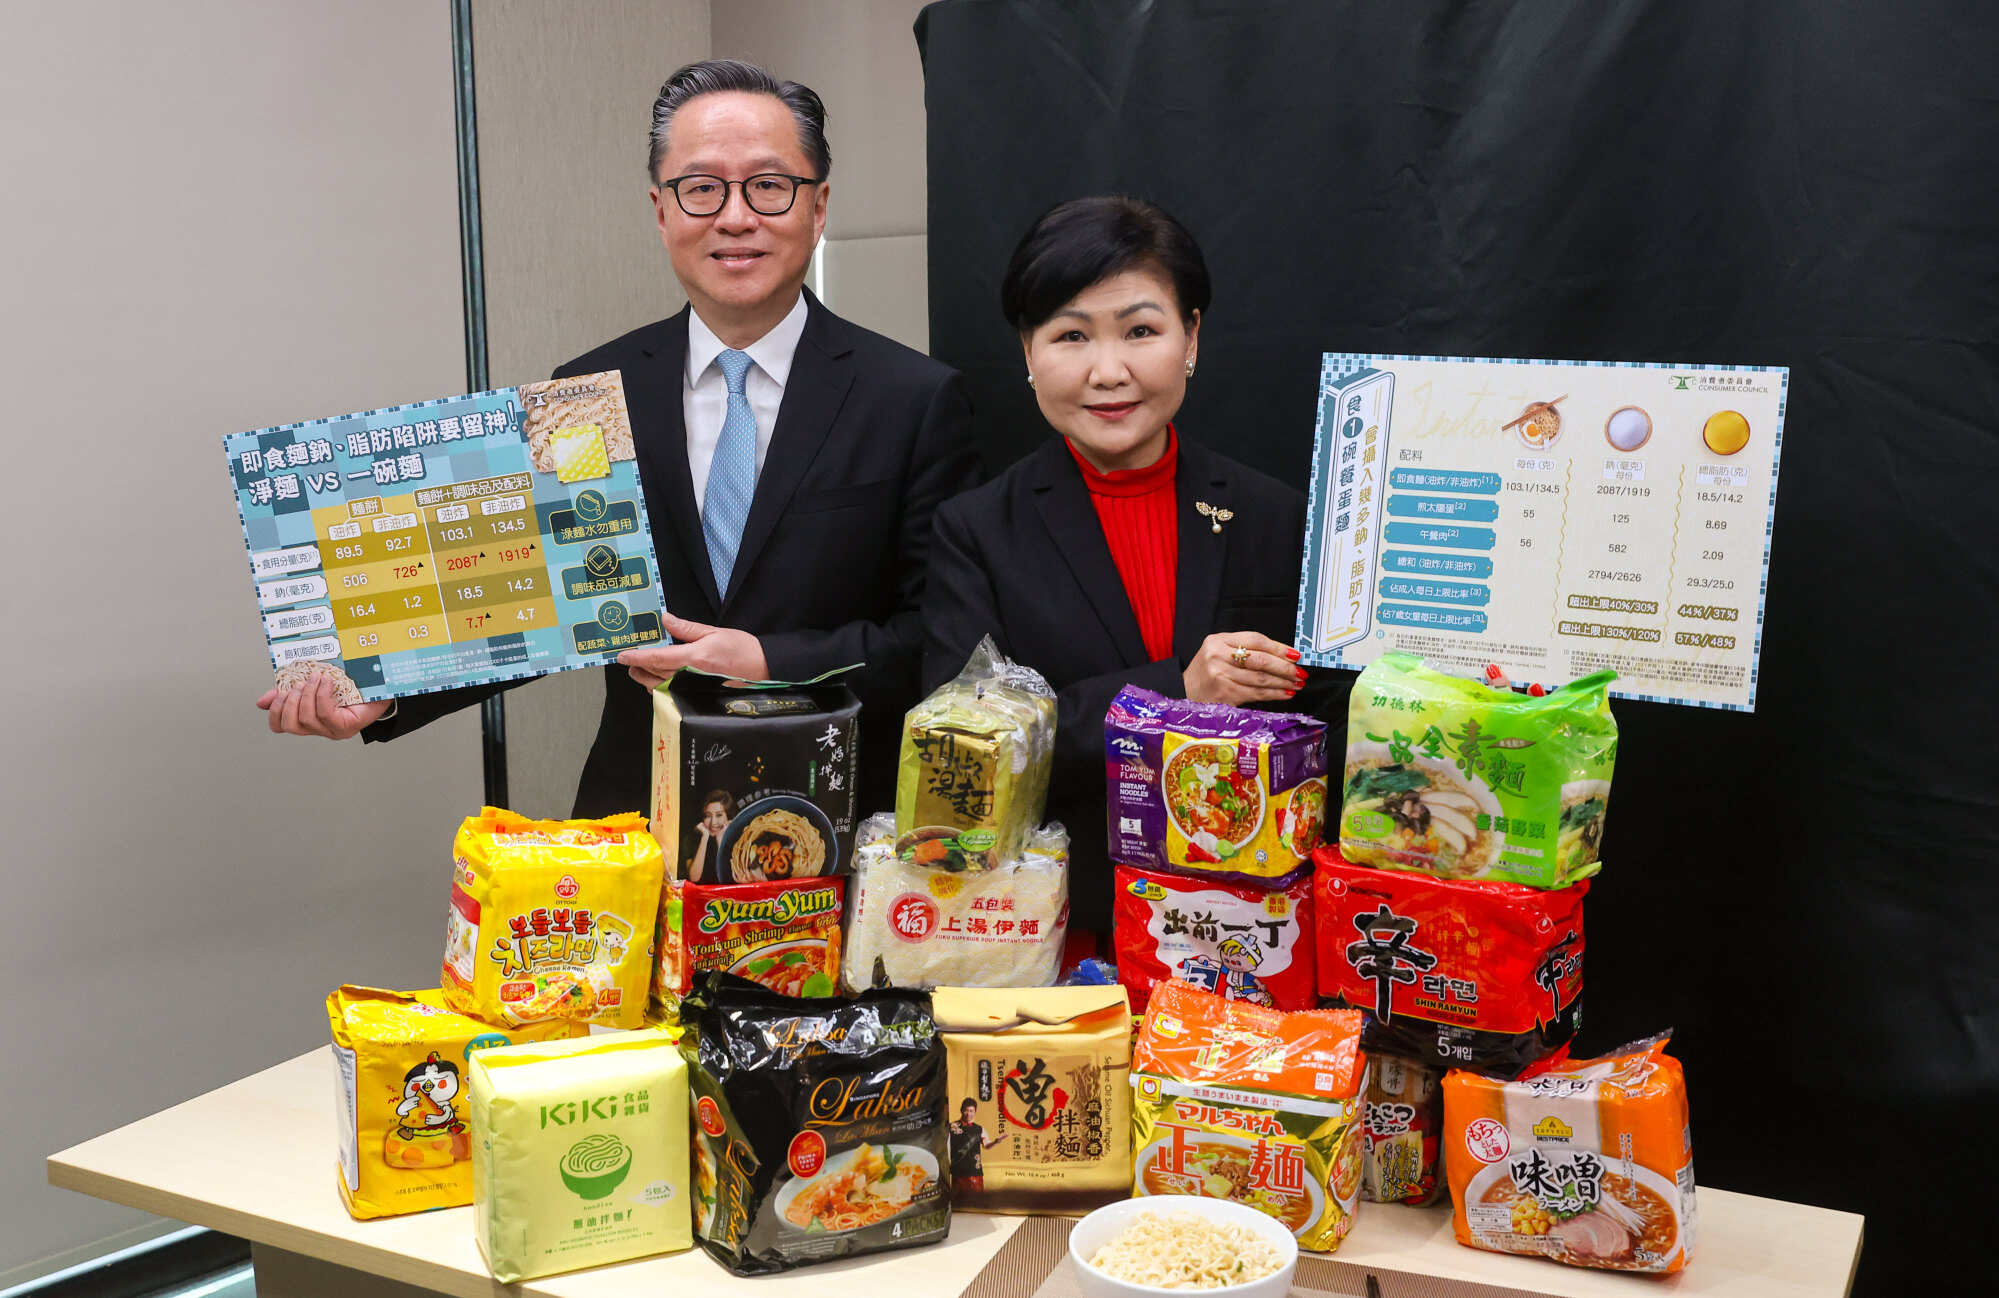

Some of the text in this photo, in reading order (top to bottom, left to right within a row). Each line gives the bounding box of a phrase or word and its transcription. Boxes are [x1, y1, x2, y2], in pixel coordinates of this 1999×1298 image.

[1698, 385, 1769, 394] CONSUMER COUNCIL
[1399, 449, 1423, 462] 配料
[249, 453, 424, 505] 淨麵 VS 一碗麵
[1505, 482, 1561, 494] 103.1/134.5
[1596, 485, 1651, 498] 2087/1919
[1696, 492, 1743, 504] 18.5/14.2
[1523, 509, 1535, 519] 55
[1612, 514, 1630, 524] 125
[491, 518, 526, 534] 134.5
[1705, 520, 1728, 531] 8.69
[440, 526, 474, 542] 103.1
[385, 536, 412, 551] 92.7
[1519, 538, 1532, 548] 56
[1608, 543, 1628, 554] 582
[335, 545, 363, 560] 89.5
[499, 547, 530, 563] 1919
[1702, 551, 1724, 561] 2.09
[447, 555, 478, 571] 2087
[393, 565, 418, 580] 726
[1588, 569, 1642, 583] 2794/2626
[343, 574, 368, 587] 506
[507, 578, 534, 592] 14.2
[1686, 577, 1734, 590] 29.3/25.0
[457, 586, 483, 600] 18.5
[403, 596, 422, 609] 1.2
[349, 603, 376, 617] 16.4
[516, 608, 535, 621] 4.7
[466, 616, 485, 629] 7.7
[408, 625, 429, 639] 0.3
[359, 633, 378, 647] 6.9
[1371, 694, 1426, 714] 功德林
[1120, 764, 1155, 775] TOM YUM
[1120, 772, 1153, 781] FLAVOUR
[1120, 782, 1147, 791] INSTANT
[1120, 789, 1149, 798] NOODLES
[1128, 821, 1134, 829] 5
[699, 898, 775, 933] Yum
[771, 887, 838, 926] Yum
[508, 908, 594, 939] 보들보들
[897, 901, 928, 935] 福
[941, 916, 1040, 936] 上湯伊麵
[1163, 908, 1290, 949] 出前一丁
[743, 926, 785, 945] Shrimp
[490, 934, 599, 979] 치즈라면
[533, 965, 561, 974] Cheese
[1346, 903, 1438, 1026] 辛
[1422, 973, 1479, 1003] 라면
[1415, 998, 1477, 1016] SHIN RAMYUN
[1006, 1057, 1056, 1129] 曾
[804, 1075, 923, 1129] Laksa
[1174, 1101, 1287, 1136] マルちゃん
[1052, 1109, 1081, 1159] 拌麵
[1467, 1123, 1502, 1142] もちっ
[1511, 1148, 1604, 1200] 味噌
[1537, 1196, 1585, 1211] ラーメン
[891, 1222, 902, 1238] 4
